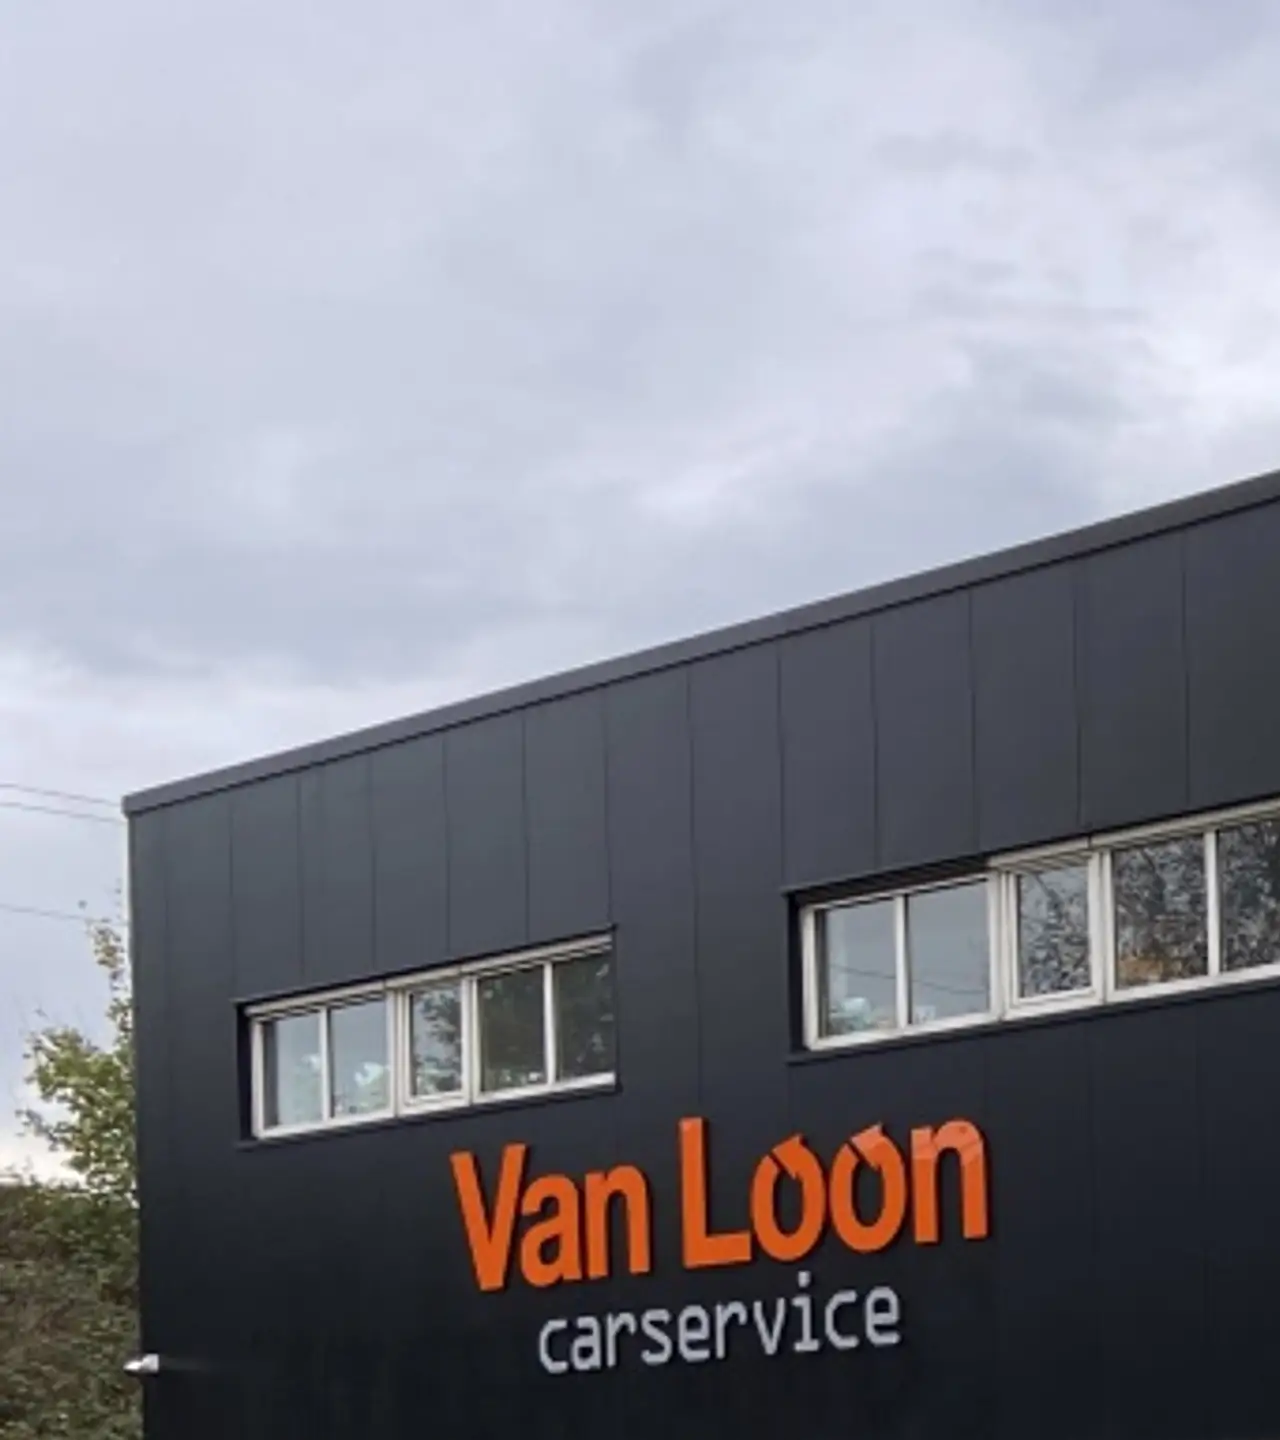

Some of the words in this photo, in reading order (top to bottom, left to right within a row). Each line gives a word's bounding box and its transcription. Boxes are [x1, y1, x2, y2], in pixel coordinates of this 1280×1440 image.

[450, 1143, 651, 1291] Van
[679, 1117, 989, 1269] Loon
[538, 1271, 901, 1374] carservice
